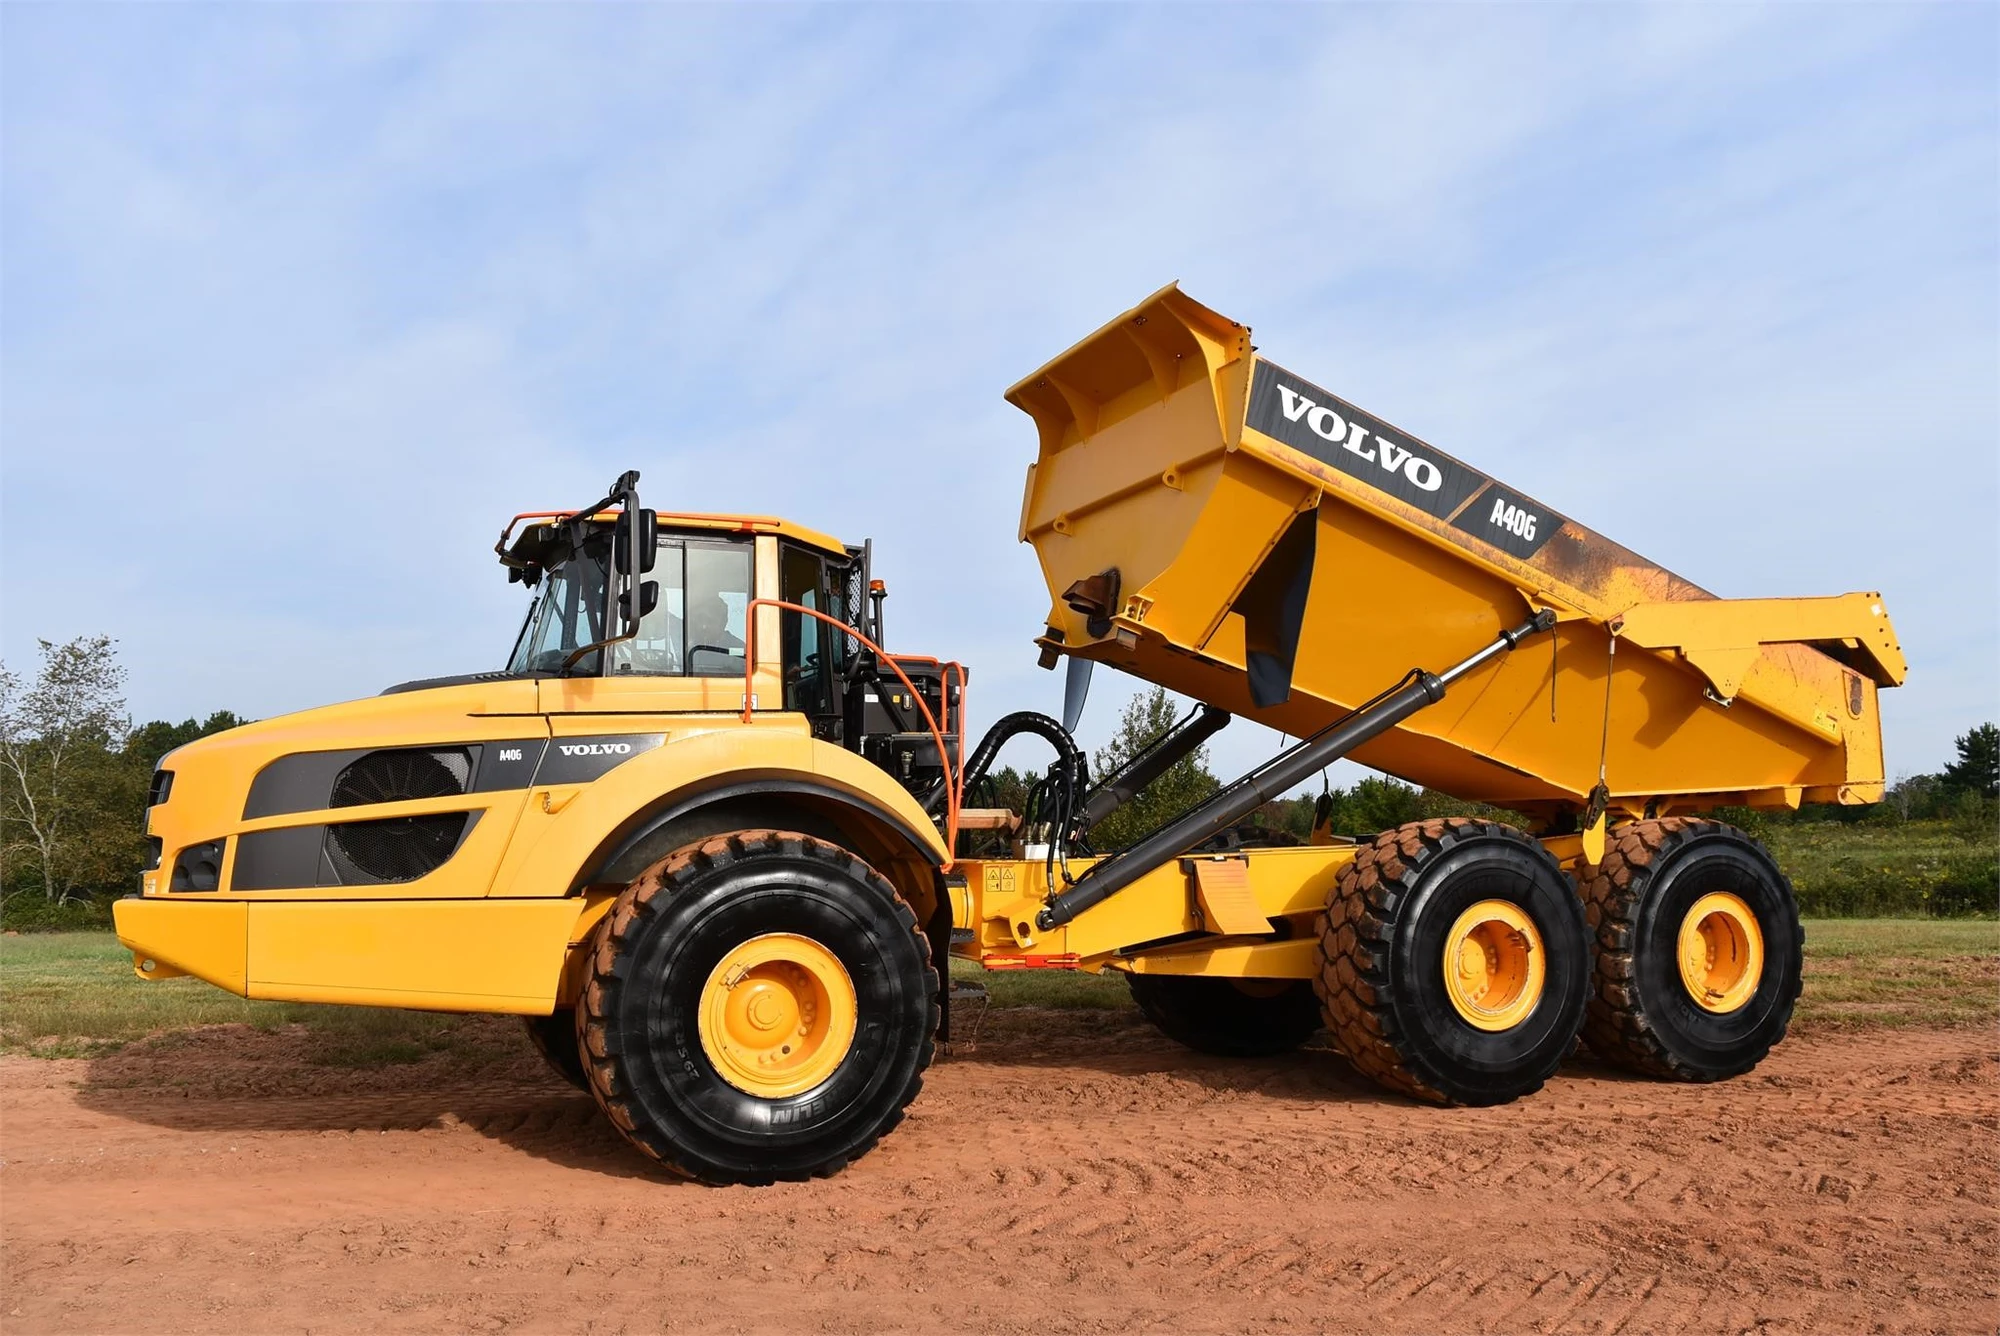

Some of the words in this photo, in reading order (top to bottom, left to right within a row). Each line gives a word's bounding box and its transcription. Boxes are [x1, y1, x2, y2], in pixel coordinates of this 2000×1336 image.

[1277, 384, 1442, 492] VOLVO
[1489, 498, 1537, 541] A40G
[499, 749, 522, 761] A40G
[559, 743, 631, 756] VOLVO
